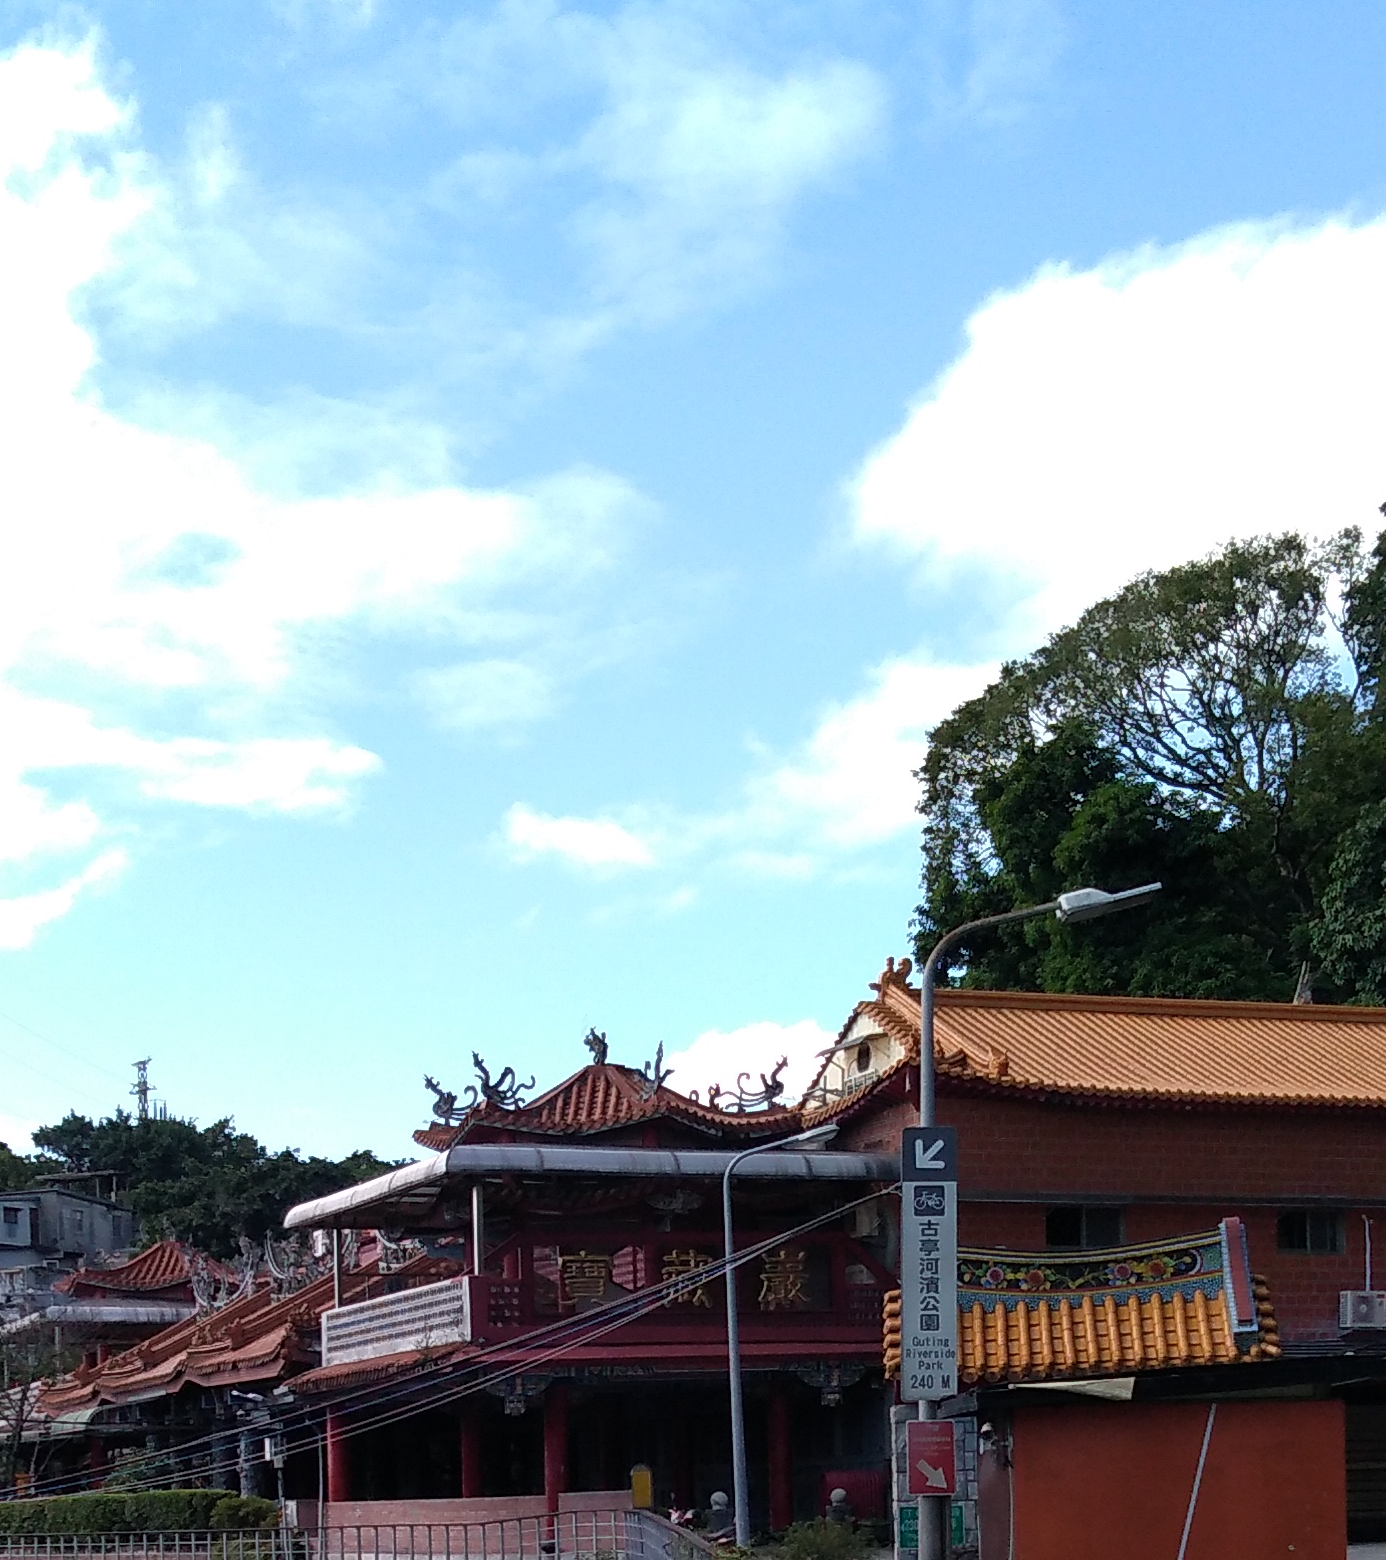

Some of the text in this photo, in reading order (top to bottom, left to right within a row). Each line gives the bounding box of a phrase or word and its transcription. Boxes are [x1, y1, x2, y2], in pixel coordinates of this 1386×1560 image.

[919, 1219, 941, 1332] 古亭河濱公園
[912, 1336, 950, 1348] Guting
[905, 1348, 956, 1359] Riverside
[918, 1360, 944, 1371] Park
[910, 1374, 951, 1389] 240 M
